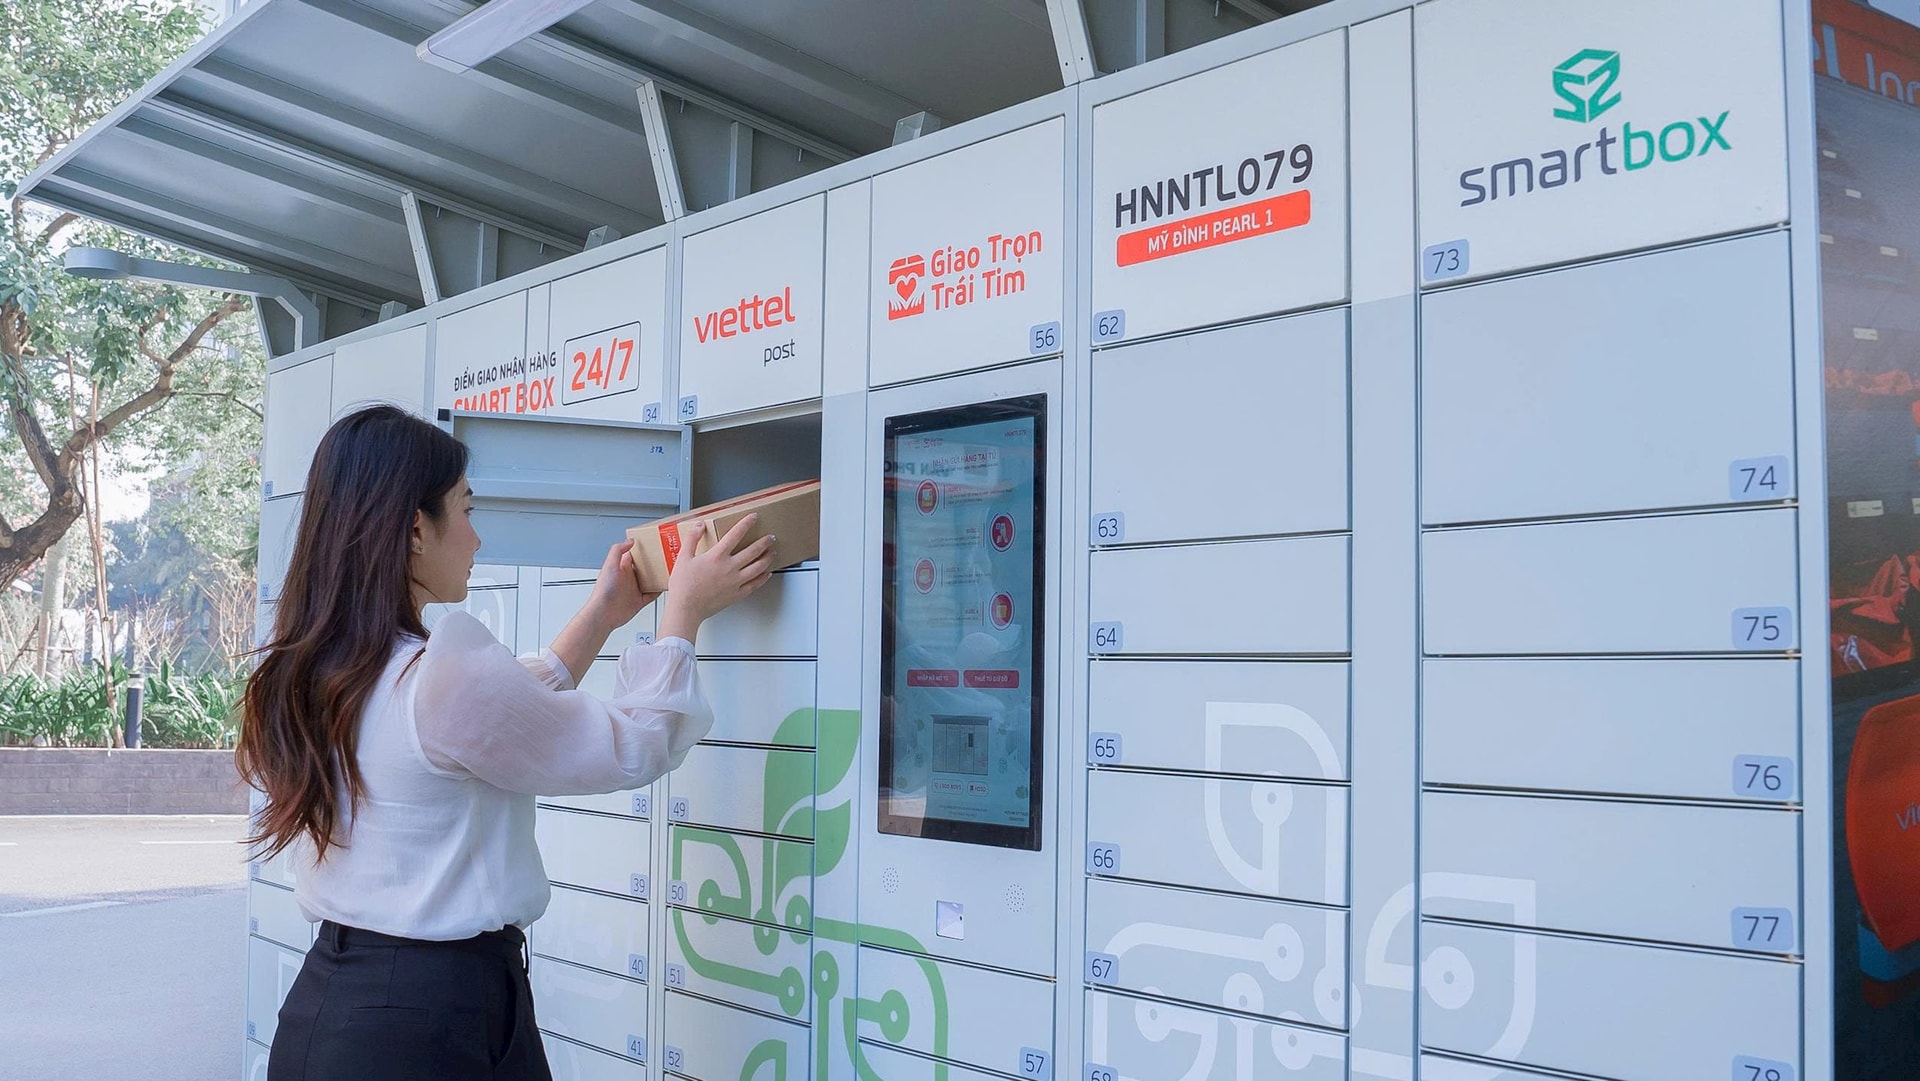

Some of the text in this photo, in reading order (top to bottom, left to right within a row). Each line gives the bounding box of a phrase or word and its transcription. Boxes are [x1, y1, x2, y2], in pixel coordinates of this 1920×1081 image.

[1459, 110, 1732, 207] smartbox
[1115, 143, 1313, 229] HNNTL079
[1148, 209, 1274, 254] MỸ ĐÌNH PEARL 1
[931, 231, 1042, 278] Giao Trọn
[1431, 248, 1460, 274] 73
[931, 267, 1025, 311] Trái Tim
[693, 286, 796, 343] viettel
[1099, 315, 1119, 336] 62
[1035, 328, 1055, 349] 56
[763, 338, 796, 367] post
[454, 351, 557, 391] ĐIỂM GIAO NHẬN HÀNG
[571, 338, 634, 392] 24/7
[516, 376, 555, 413] BOX
[645, 407, 657, 422] 34
[682, 400, 695, 415] 45
[1739, 465, 1778, 492] 74
[1098, 518, 1118, 538] 63
[1095, 627, 1116, 648] 64
[1742, 616, 1780, 642] 75
[1094, 738, 1115, 759] 65
[1744, 763, 1781, 790] 76
[635, 798, 647, 814] 38
[673, 802, 686, 817] 49
[1093, 848, 1114, 869] 66
[633, 878, 645, 893] 39
[671, 885, 684, 900] 50
[1743, 916, 1779, 942] 77
[631, 959, 644, 974] 40
[669, 968, 681, 984] 51
[1091, 958, 1112, 979] 67
[630, 1039, 642, 1056] 41
[668, 1052, 681, 1068] 52
[1025, 1053, 1045, 1074] 57
